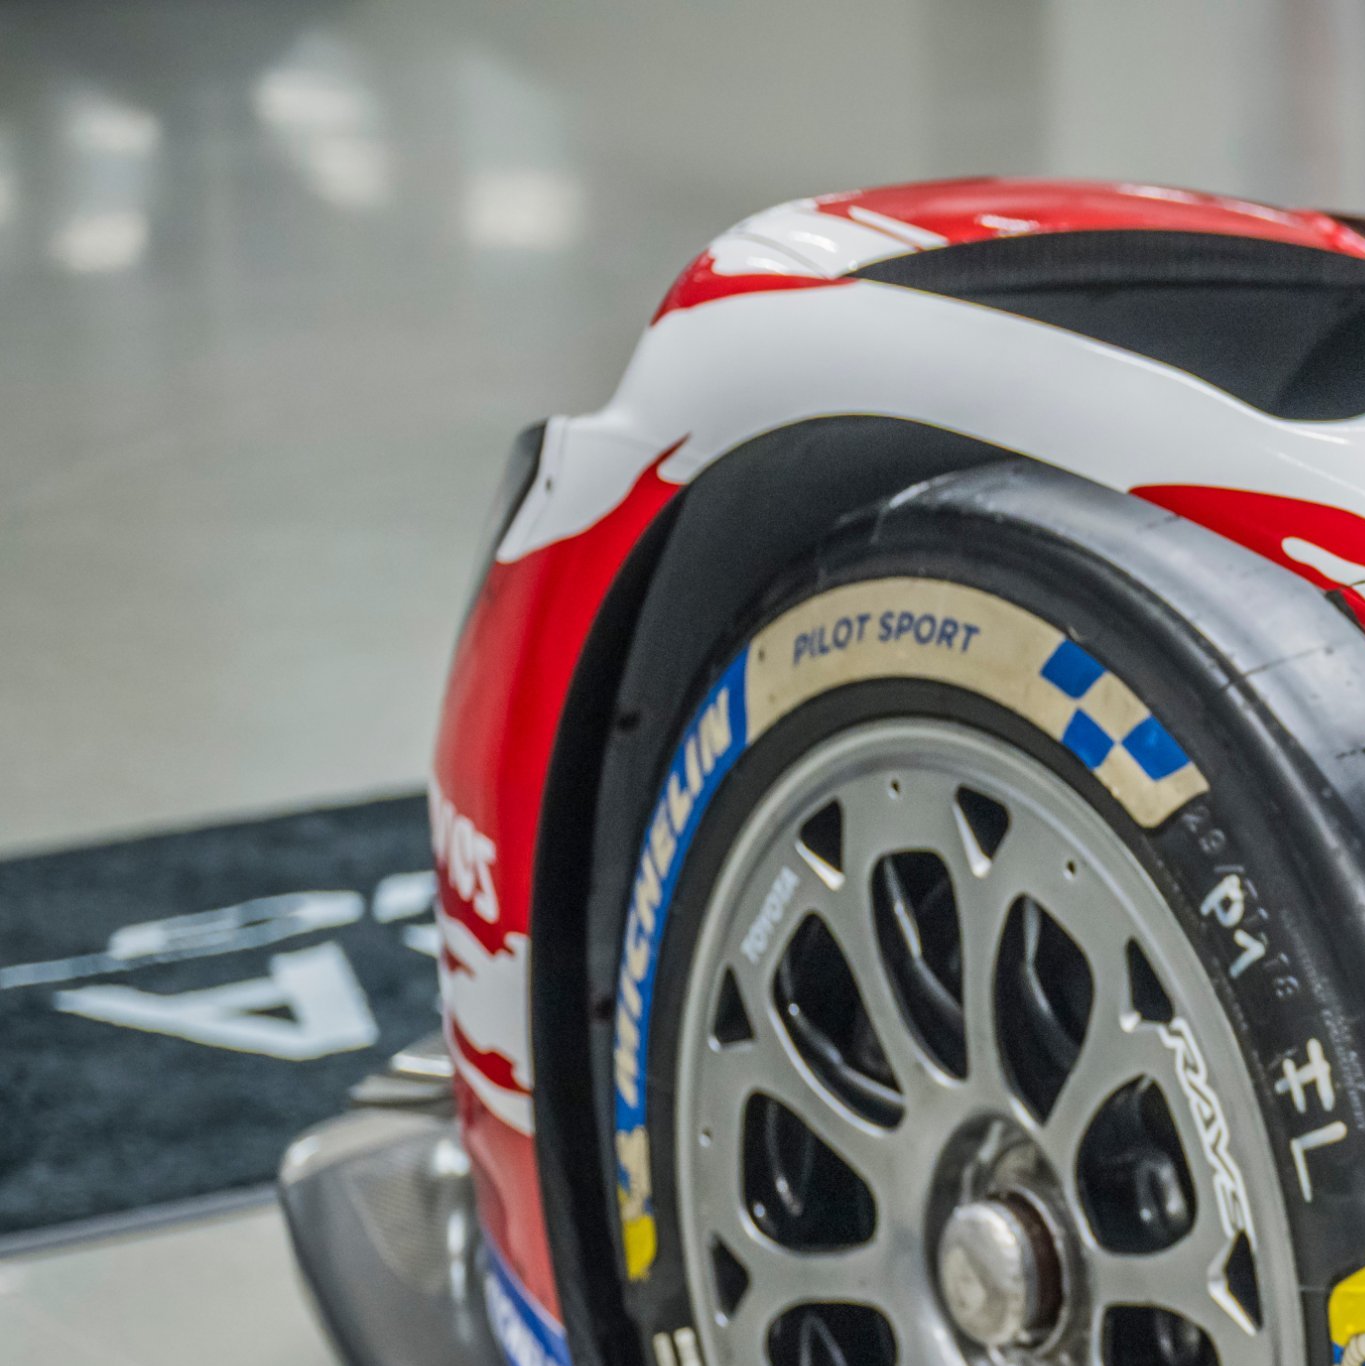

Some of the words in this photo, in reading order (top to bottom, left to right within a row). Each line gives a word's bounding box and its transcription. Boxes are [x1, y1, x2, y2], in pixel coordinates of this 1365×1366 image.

[792, 612, 870, 667] PILOT
[877, 610, 981, 654] SPORT
[614, 686, 733, 1109] MICHELIN
